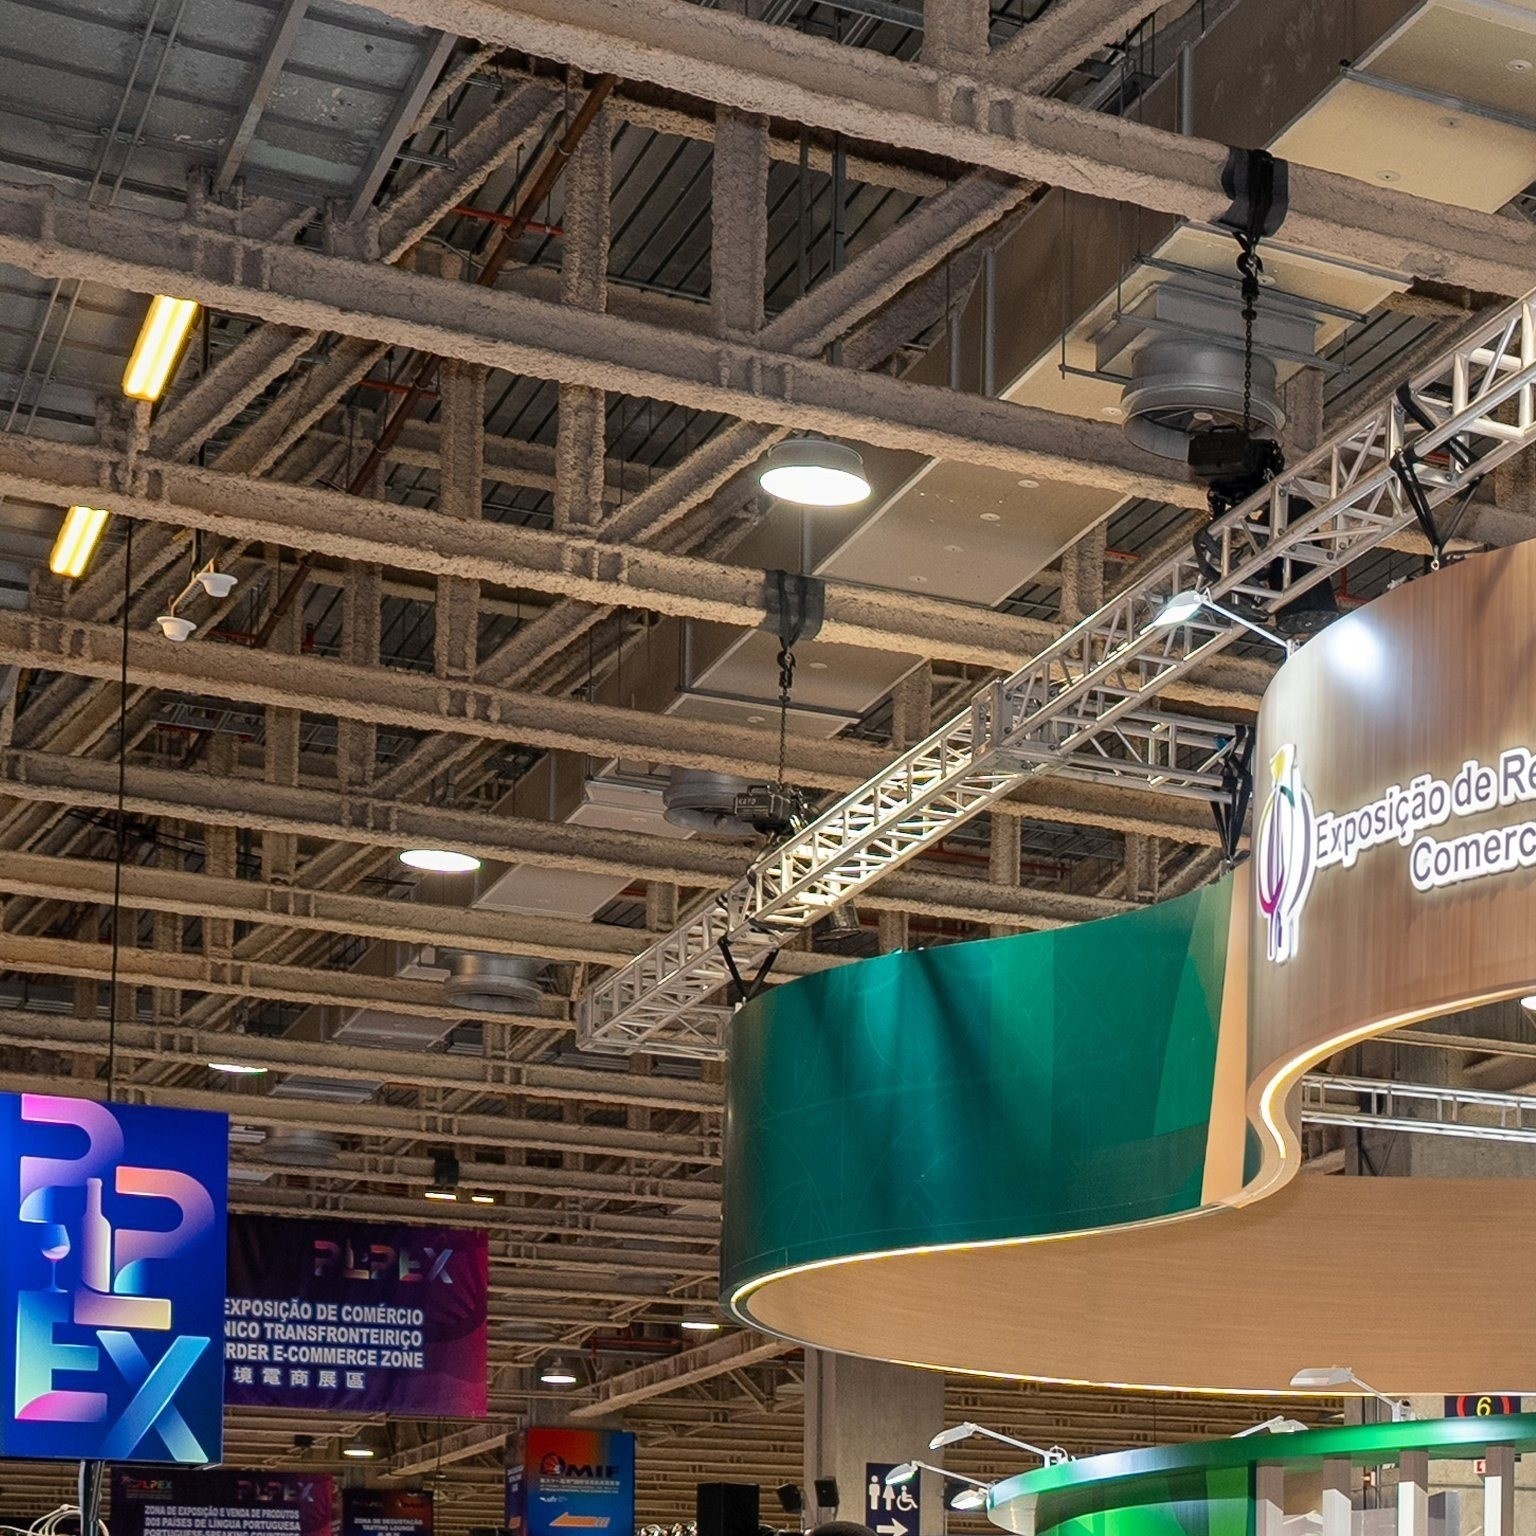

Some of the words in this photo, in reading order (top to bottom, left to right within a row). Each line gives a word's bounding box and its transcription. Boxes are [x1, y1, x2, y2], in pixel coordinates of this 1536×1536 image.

[1315, 780, 1446, 860] Exposição
[1454, 762, 1492, 808] de
[316, 1303, 338, 1322] DE
[341, 1303, 424, 1326] COMÉRCIO
[264, 1322, 422, 1347] TRANSFRONTEIRIÇO
[224, 1344, 269, 1361] RDER
[273, 1346, 377, 1366] E-COMMERCE
[380, 1351, 424, 1368] ZONE
[167, 1506, 177, 1516] DE
[251, 1509, 261, 1518] DE
[194, 1518, 206, 1528] DE
[243, 1519, 301, 1531] PORTUGUESA
